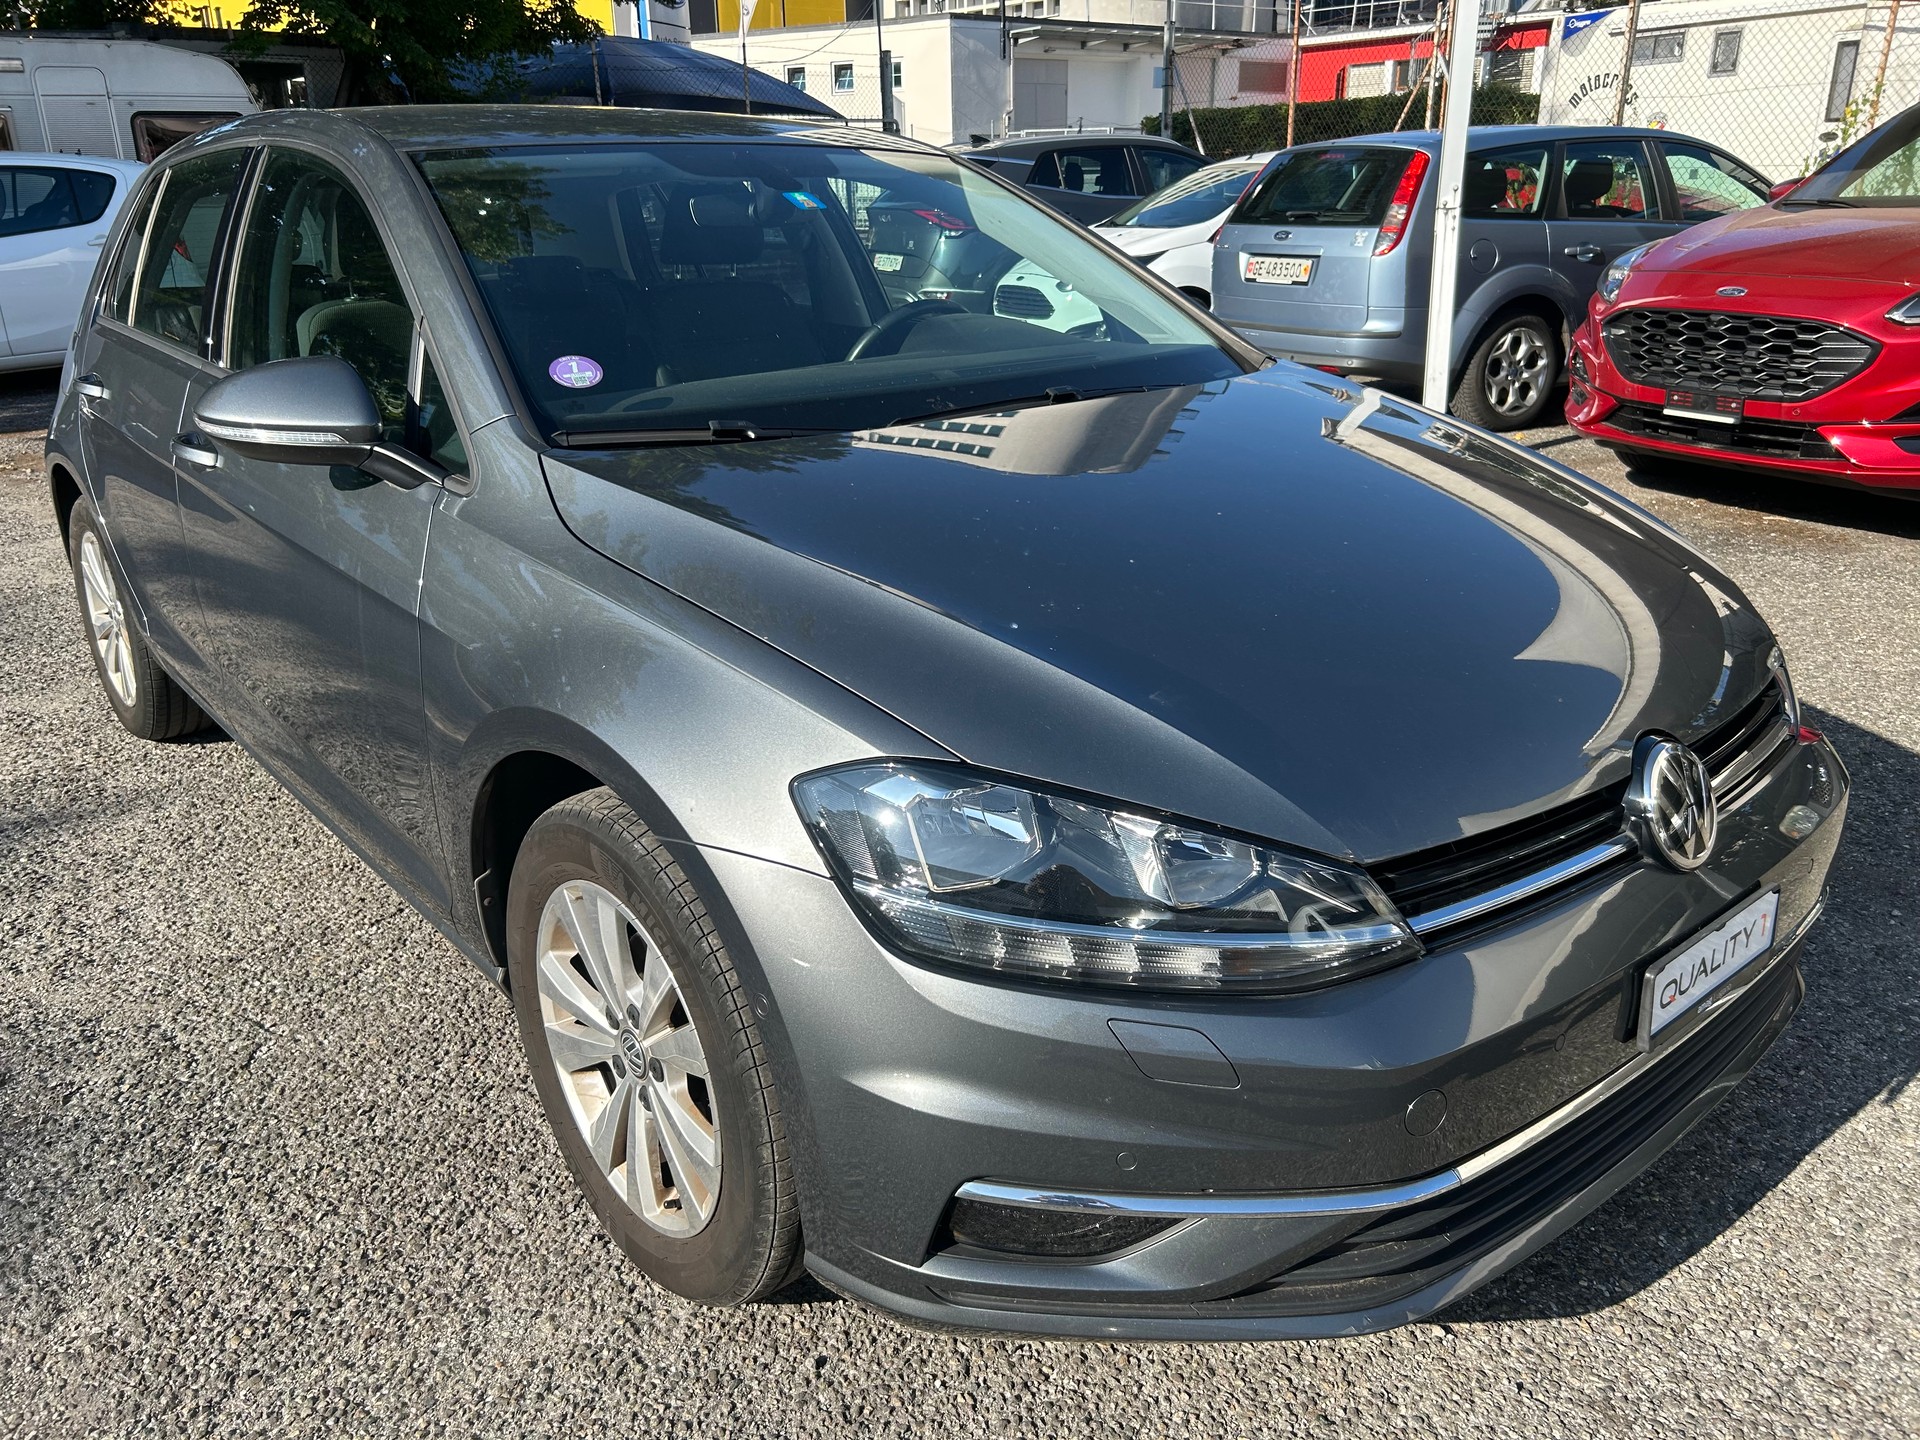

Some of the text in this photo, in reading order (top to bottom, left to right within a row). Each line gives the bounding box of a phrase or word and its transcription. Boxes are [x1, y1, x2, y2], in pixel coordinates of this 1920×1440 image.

[1568, 72, 1639, 109] motocrs
[568, 361, 578, 373] 1
[1660, 919, 1757, 1009] QUALITY
